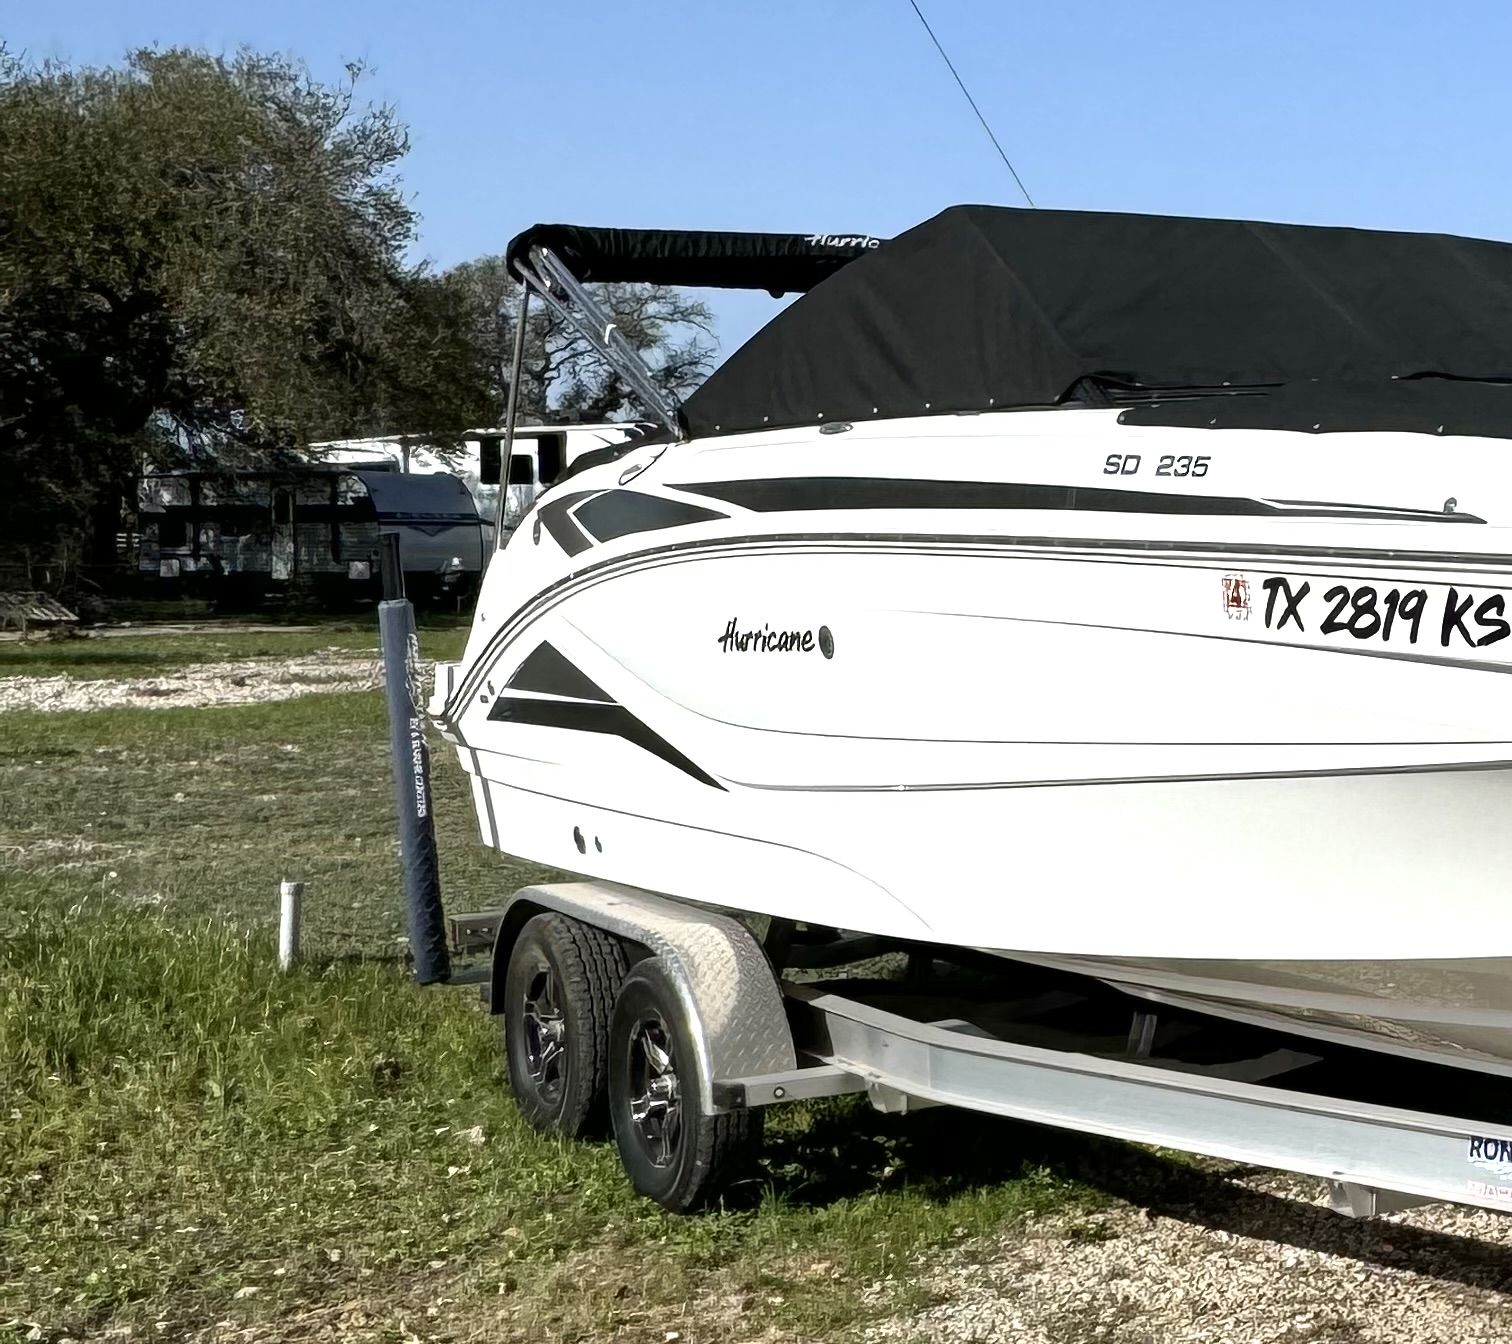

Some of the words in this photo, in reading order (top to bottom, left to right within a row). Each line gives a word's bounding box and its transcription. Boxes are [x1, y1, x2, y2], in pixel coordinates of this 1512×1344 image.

[1103, 454, 1141, 475] SD
[1155, 455, 1211, 477] 235
[1263, 577, 1311, 632] TX
[1320, 585, 1428, 644] 2819
[1441, 586, 1511, 648] KS
[718, 617, 815, 653] Hurricane
